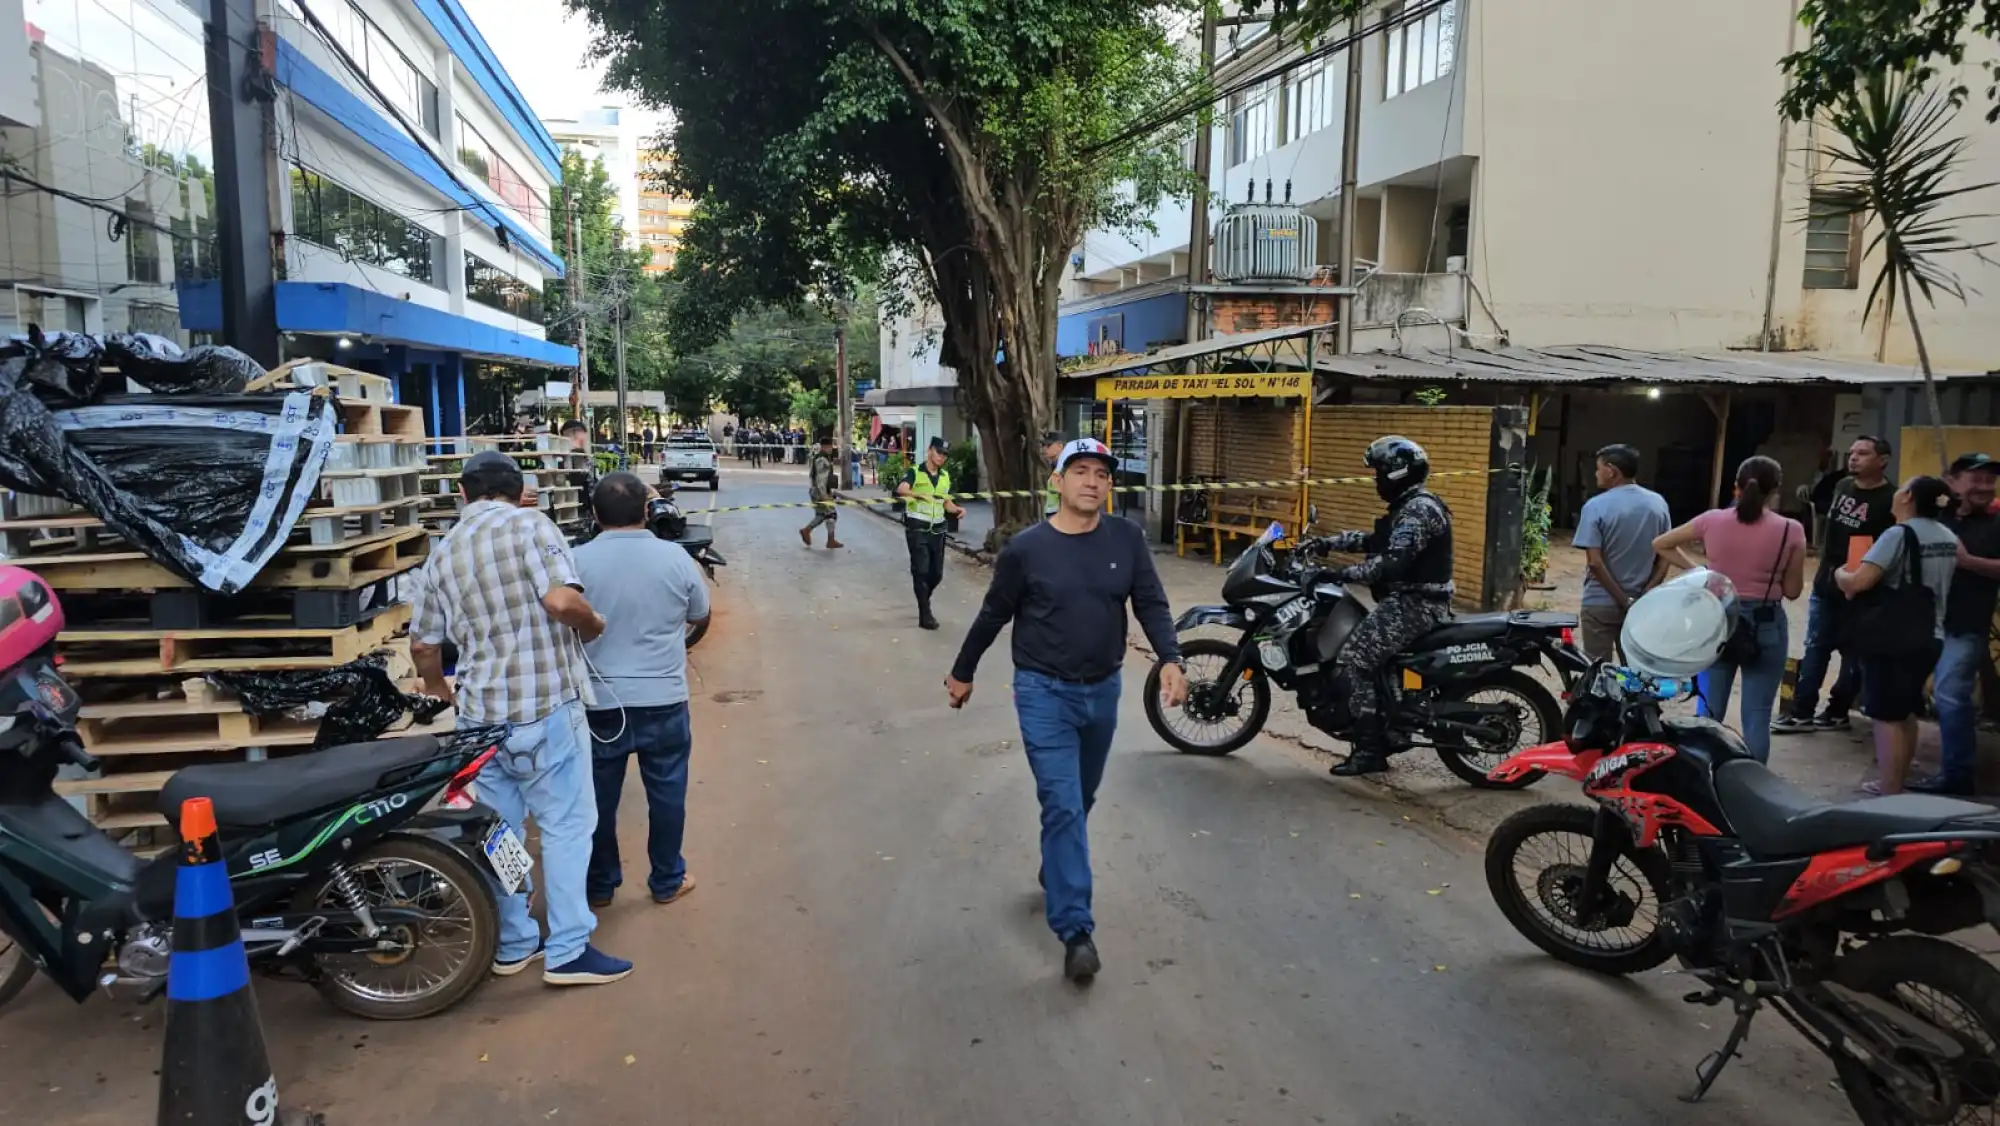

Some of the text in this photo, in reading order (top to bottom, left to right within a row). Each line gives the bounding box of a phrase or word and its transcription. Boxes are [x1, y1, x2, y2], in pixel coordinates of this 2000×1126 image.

[1114, 379, 1159, 391] PARADA
[1163, 379, 1178, 389] DE
[1182, 378, 1209, 389] TAXI
[1076, 441, 1090, 452] LA
[1590, 754, 1628, 780] TAIGA
[249, 848, 283, 870] SE
